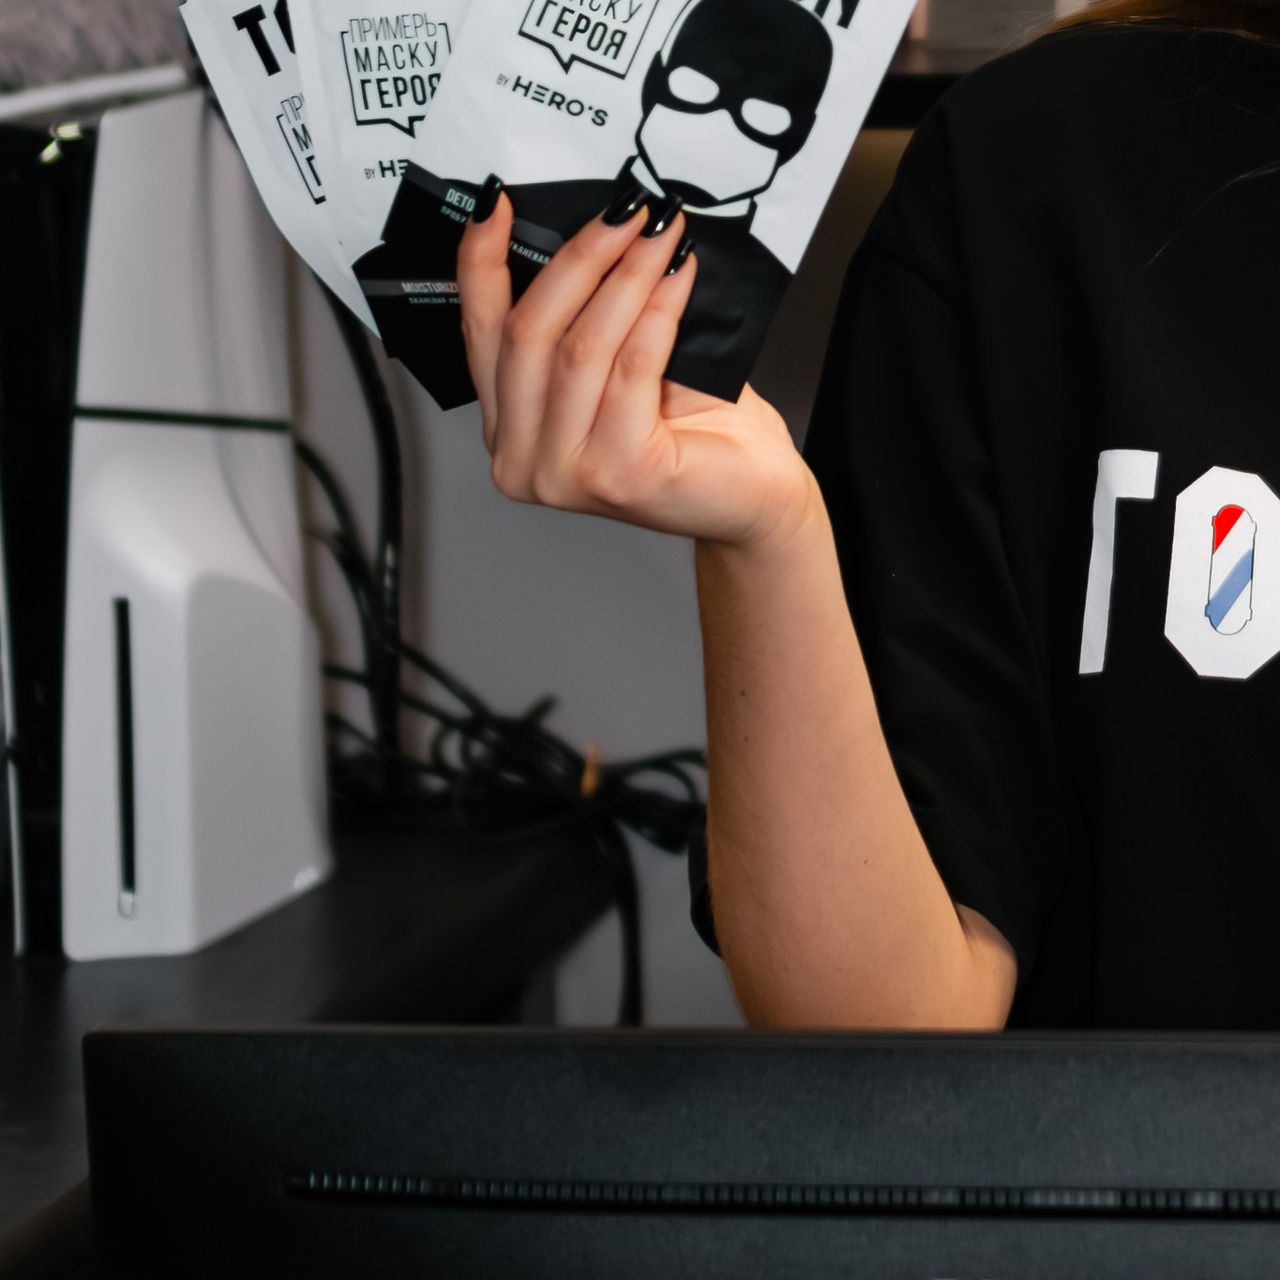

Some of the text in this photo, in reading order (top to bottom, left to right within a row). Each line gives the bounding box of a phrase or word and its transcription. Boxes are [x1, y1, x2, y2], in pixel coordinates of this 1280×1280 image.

[350, 12, 437, 43] ПРИМЕРЬ
[536, 0, 627, 60] ГЕРОЯ
[354, 41, 437, 72] МАСКУ
